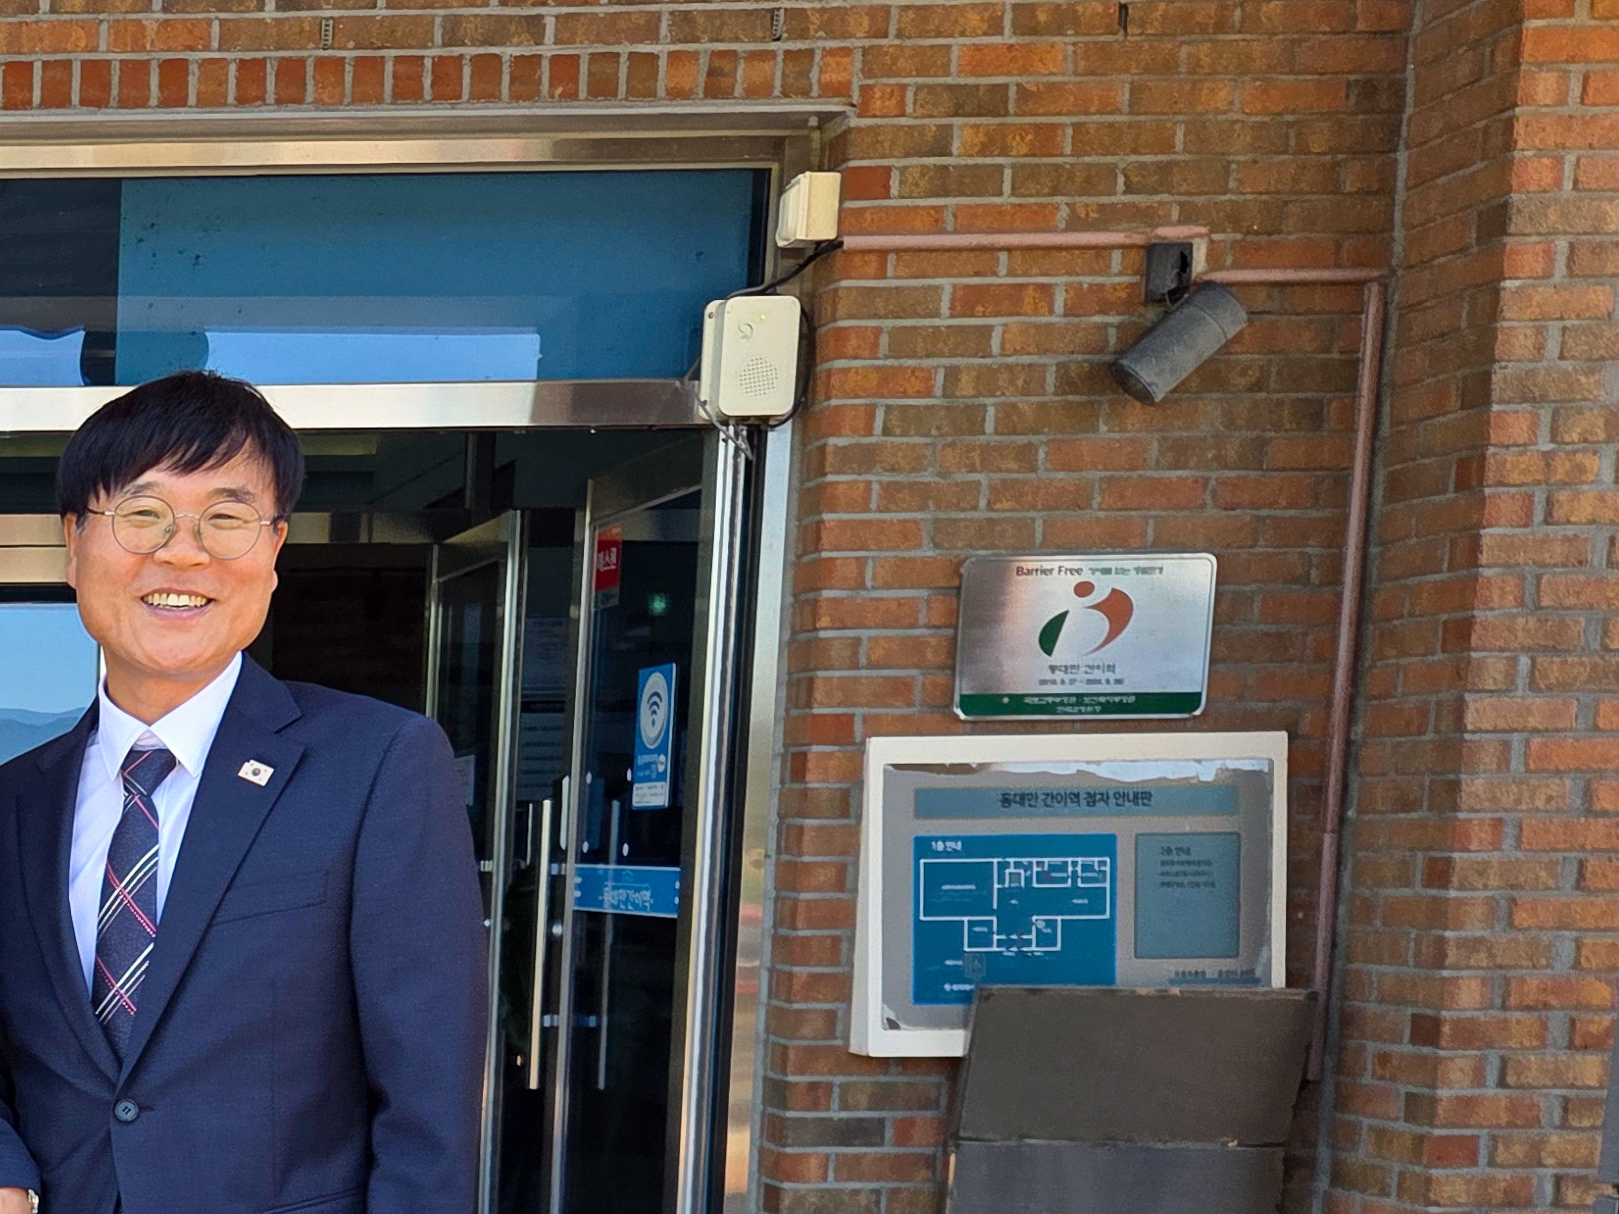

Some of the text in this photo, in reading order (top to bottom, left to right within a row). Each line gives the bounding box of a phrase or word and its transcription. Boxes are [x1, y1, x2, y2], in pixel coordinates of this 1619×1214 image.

[1016, 565, 1055, 577] Barrier
[1057, 565, 1084, 576] Free
[1041, 791, 1080, 808] 간이역
[1113, 790, 1153, 807] 안내판
